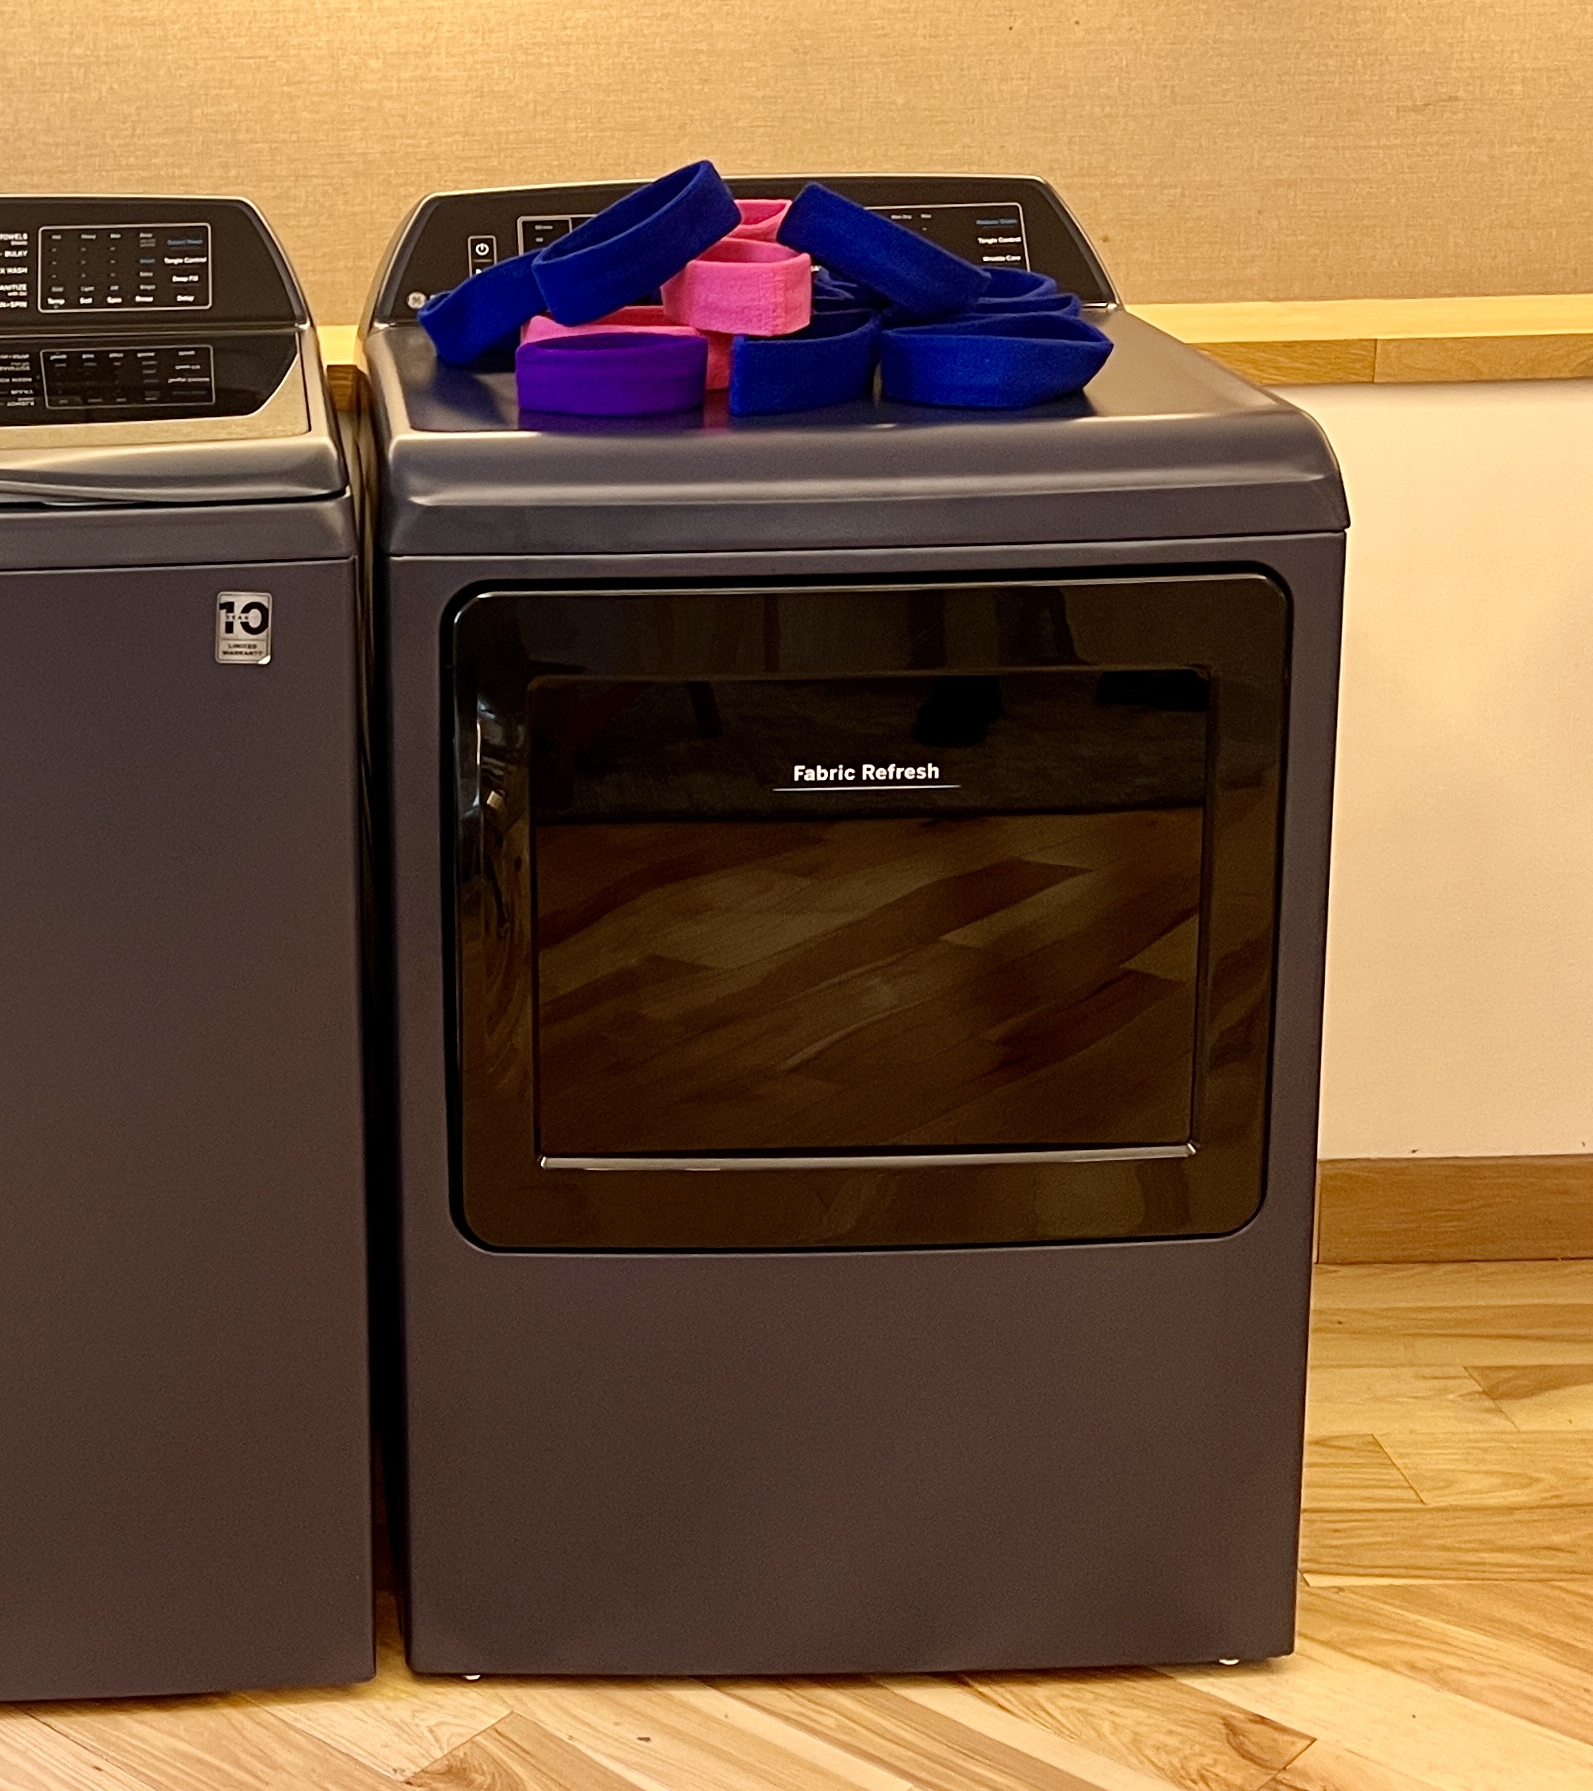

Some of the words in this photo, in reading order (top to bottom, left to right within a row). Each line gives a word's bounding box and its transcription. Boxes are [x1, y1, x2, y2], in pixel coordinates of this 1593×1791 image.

[977, 237, 999, 245] Tangle
[996, 236, 1022, 244] Control
[4, 249, 29, 258] BULKY
[5, 266, 28, 274] WASH
[219, 601, 269, 635] 10
[794, 765, 855, 781] Fabric
[862, 763, 939, 780] Refresh
